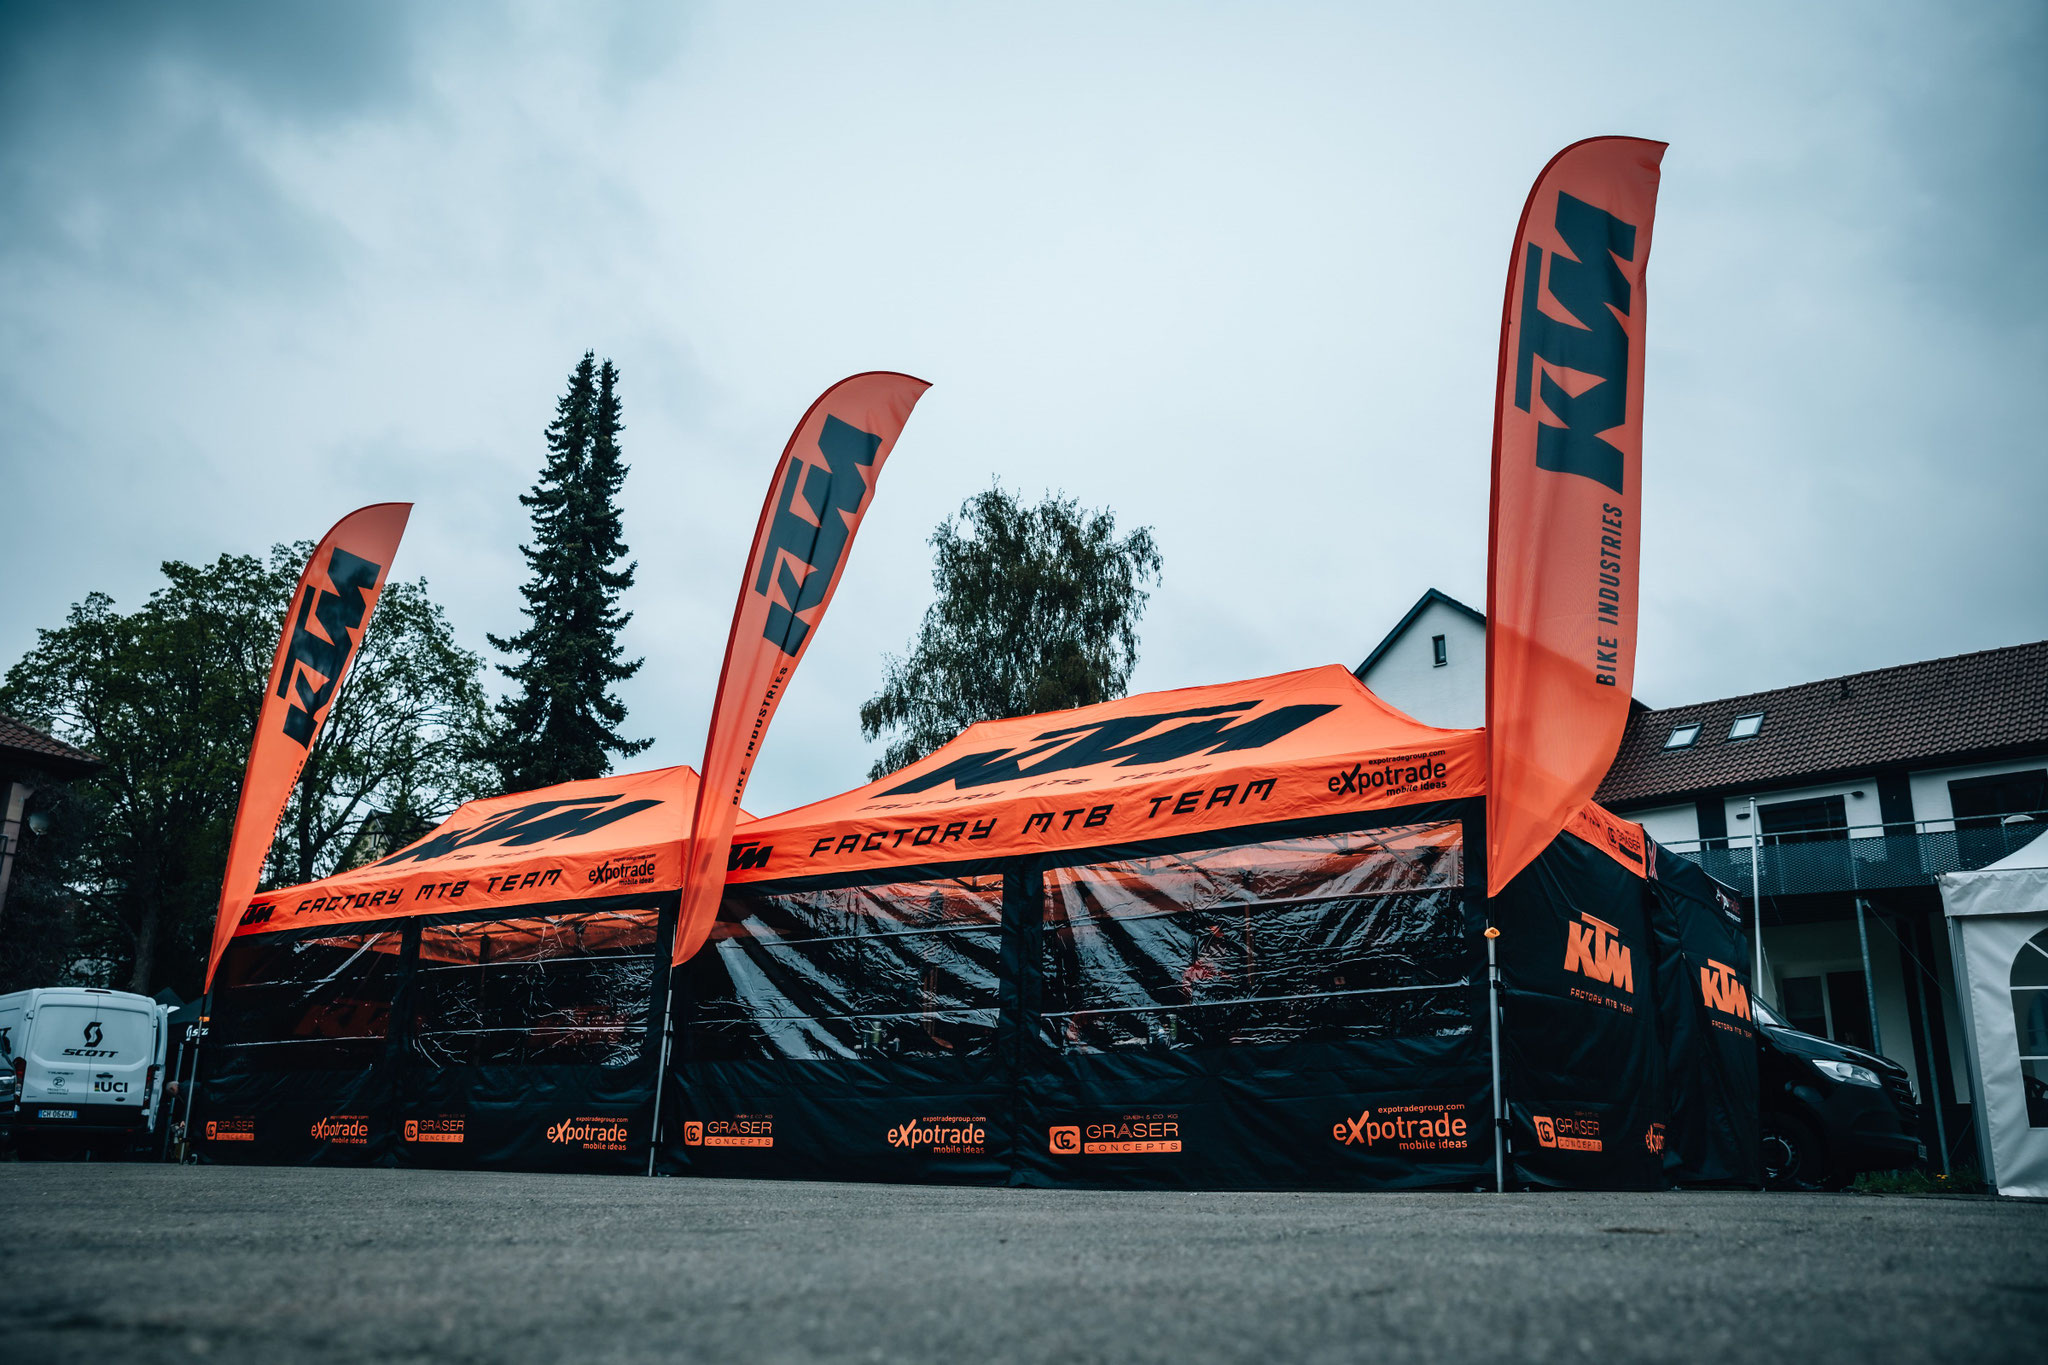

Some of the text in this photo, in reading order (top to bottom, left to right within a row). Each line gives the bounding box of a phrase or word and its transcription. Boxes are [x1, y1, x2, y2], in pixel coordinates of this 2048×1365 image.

[1514, 190, 1637, 496] KTM
[754, 413, 883, 657] KTM
[1596, 502, 1623, 687] BIKE INDUSTRIES
[276, 546, 382, 751] KTM
[732, 666, 789, 806] BIKE INDUSTRIES
[869, 700, 1343, 799] KTM
[1368, 749, 1446, 766] expotradegroup.com
[1386, 779, 1448, 798] mobile ideas
[809, 777, 1278, 858] FACTORY MTB TEAM
[295, 868, 563, 915] FACTORY MTB TEAM
[1563, 911, 1634, 994] KTM
[1570, 987, 1603, 1005] FACTORY
[1700, 958, 1752, 1022] KTM
[62, 1048, 119, 1058] SCOTT
[101, 1081, 129, 1093] UCI
[1377, 1103, 1466, 1115] expotradegroup.com
[420, 1119, 465, 1131] GRASER
[707, 1120, 773, 1134] GRASER
[922, 1115, 987, 1124] expotradegroup.com
[1555, 1117, 1600, 1136] GRASER
[419, 1134, 463, 1142] CONCEPTS
[1086, 1122, 1180, 1139] GRASER
[583, 1142, 627, 1151] mobile ideas
[706, 1137, 772, 1146] CONCEPTS
[933, 1144, 985, 1154] mobile ideas
[1086, 1142, 1180, 1153] CONCEPTS
[1399, 1139, 1468, 1151] mobile ideas
